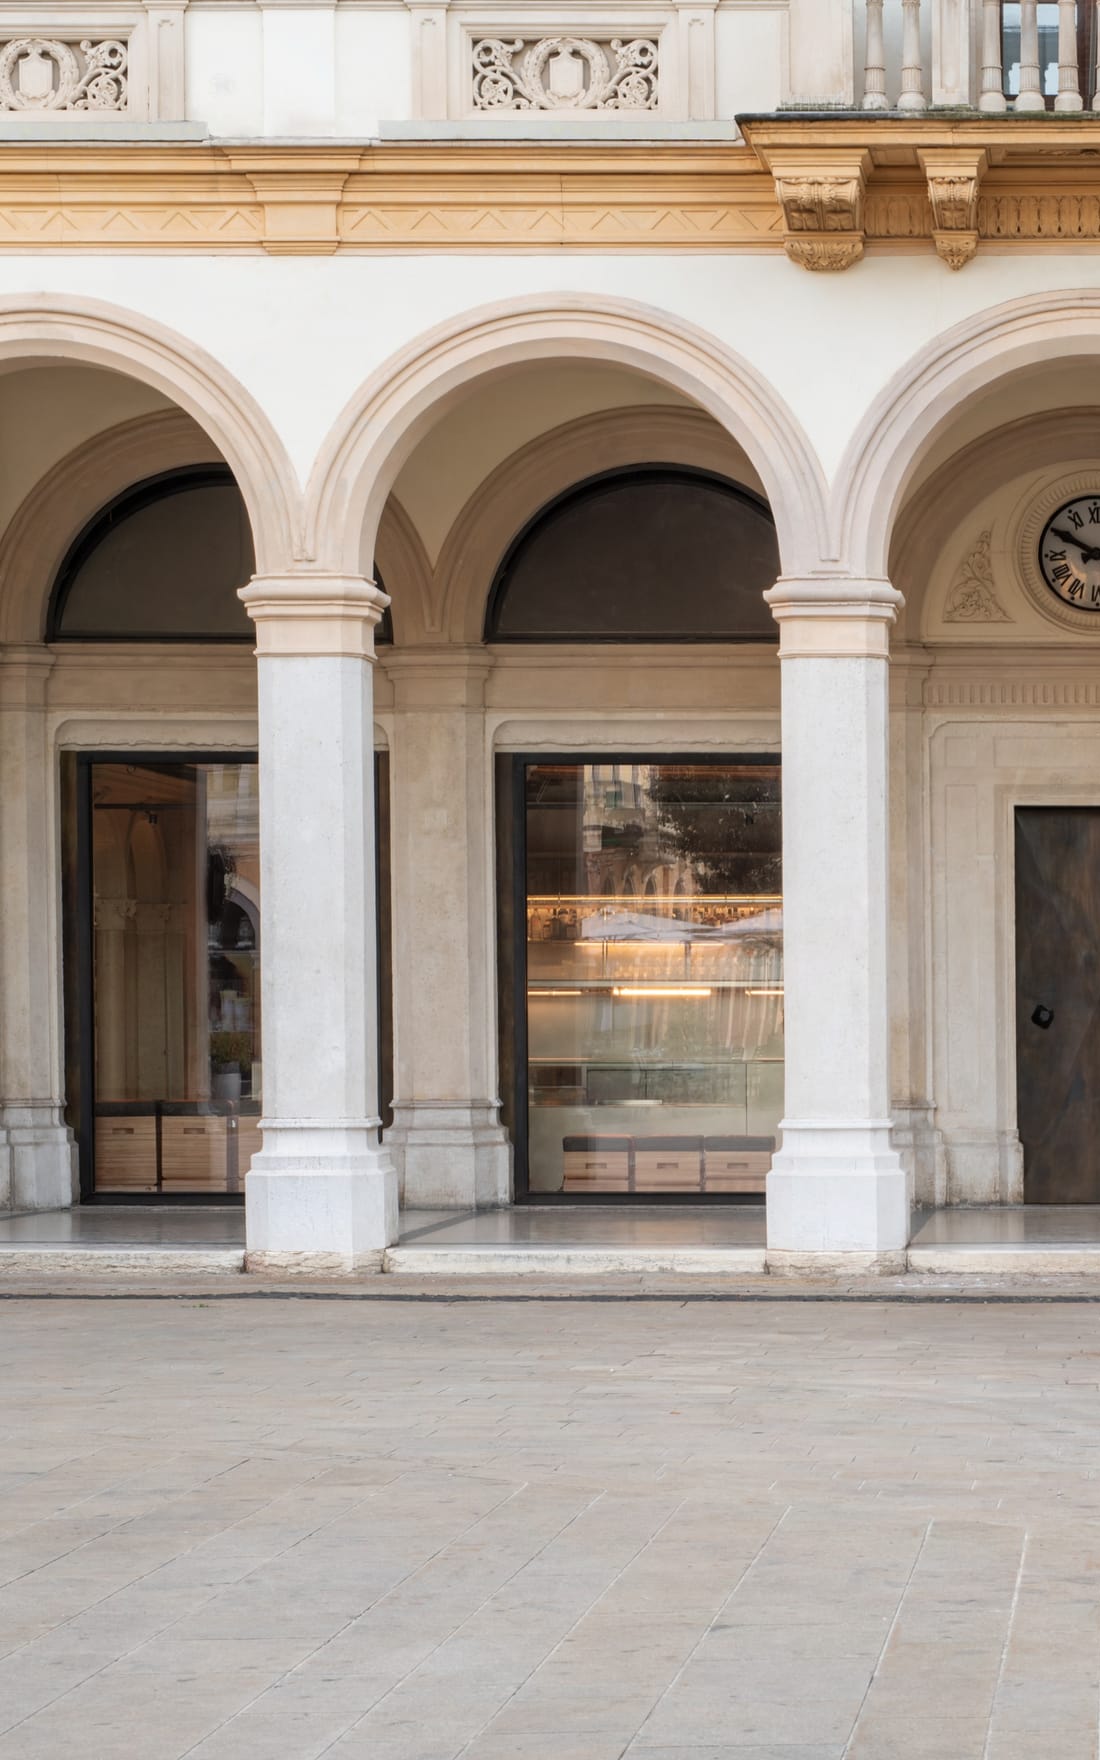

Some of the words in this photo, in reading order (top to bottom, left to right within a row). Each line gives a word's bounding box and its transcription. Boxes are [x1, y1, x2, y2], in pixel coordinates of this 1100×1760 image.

[1068, 511, 1084, 530] XI
[1050, 550, 1066, 561] IX
[1052, 564, 1072, 586] VIII
[1068, 579, 1085, 599] VII
